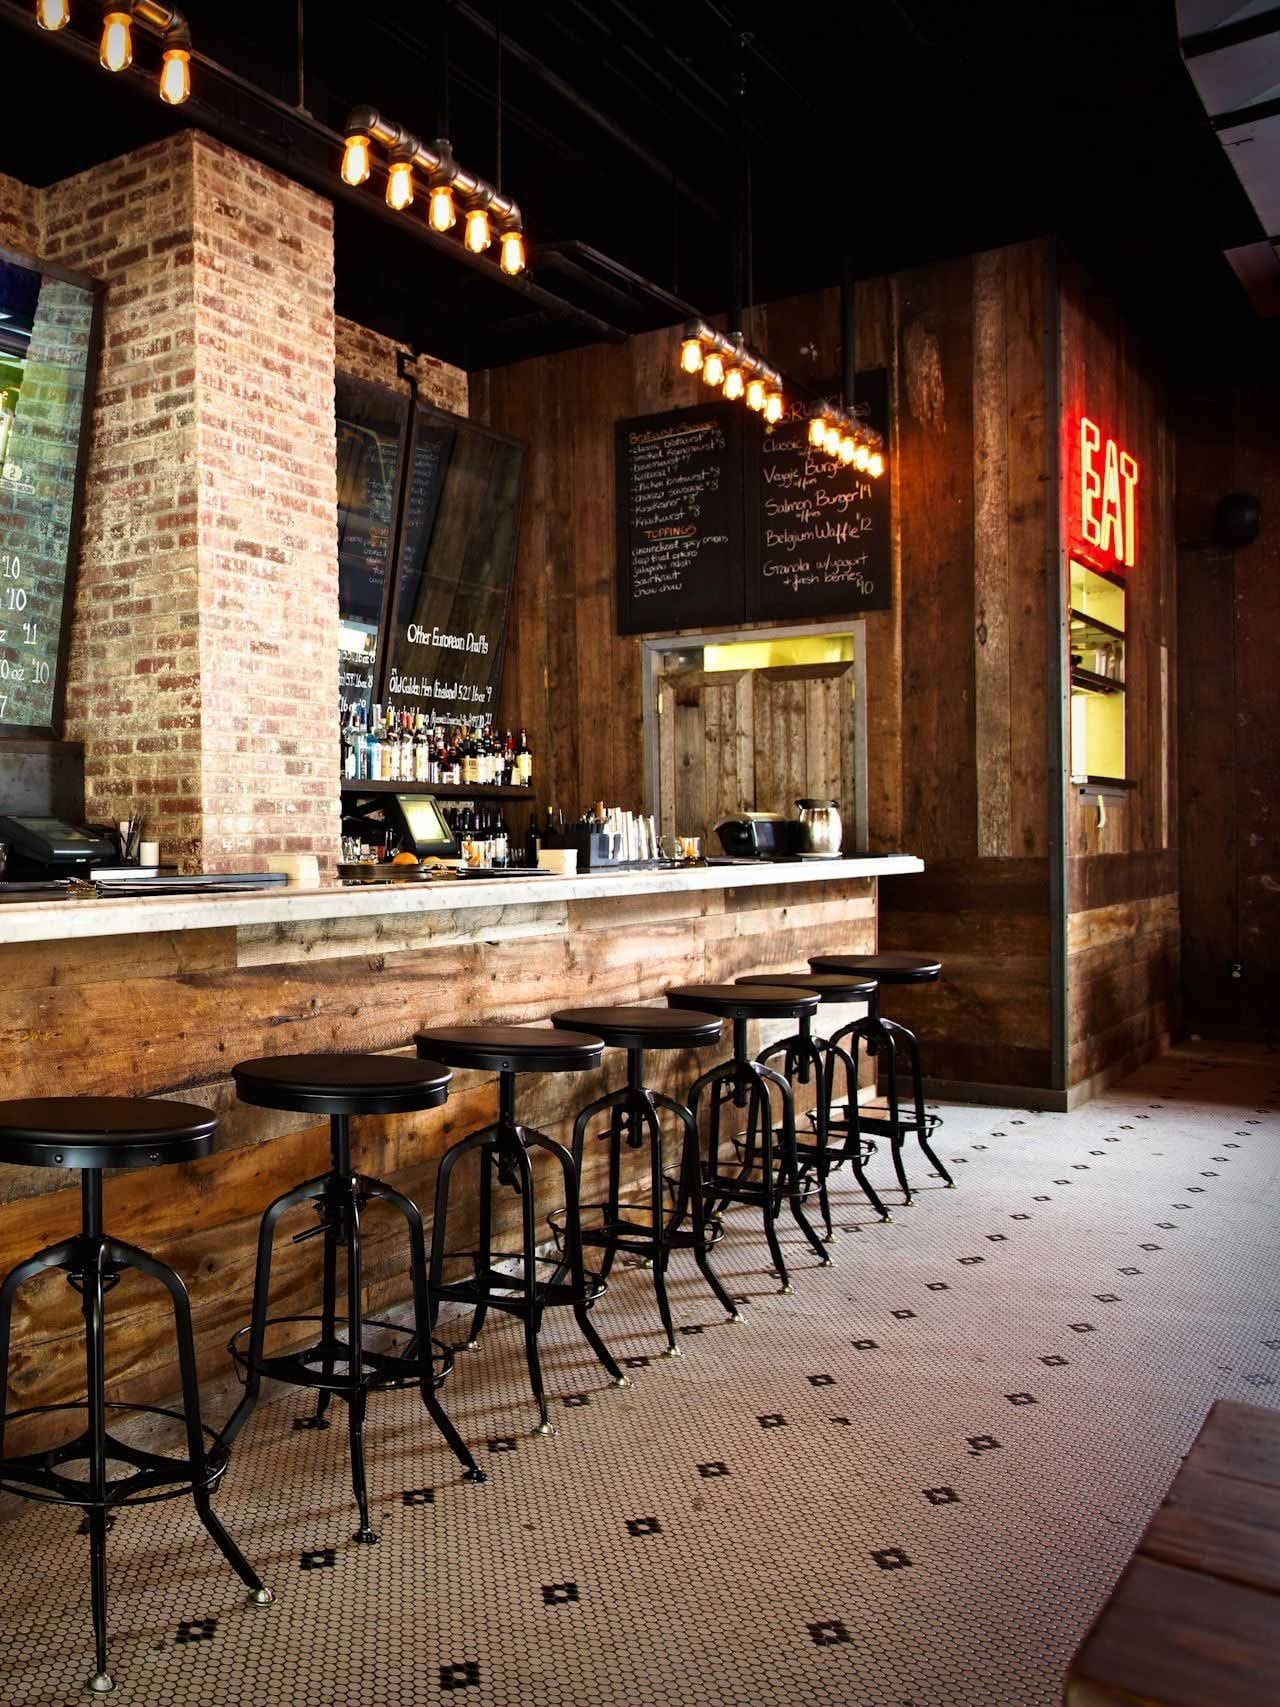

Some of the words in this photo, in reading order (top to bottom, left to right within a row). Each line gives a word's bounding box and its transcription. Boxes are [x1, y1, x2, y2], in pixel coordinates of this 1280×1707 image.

[765, 498, 814, 516] Salmon
[816, 488, 859, 513] Burger
[766, 528, 815, 552] Belgium
[762, 558, 810, 577] Granola
[406, 623, 432, 646] Other
[432, 626, 466, 651] European
[465, 632, 489, 655] Drafts
[10, 669, 25, 681] oz
